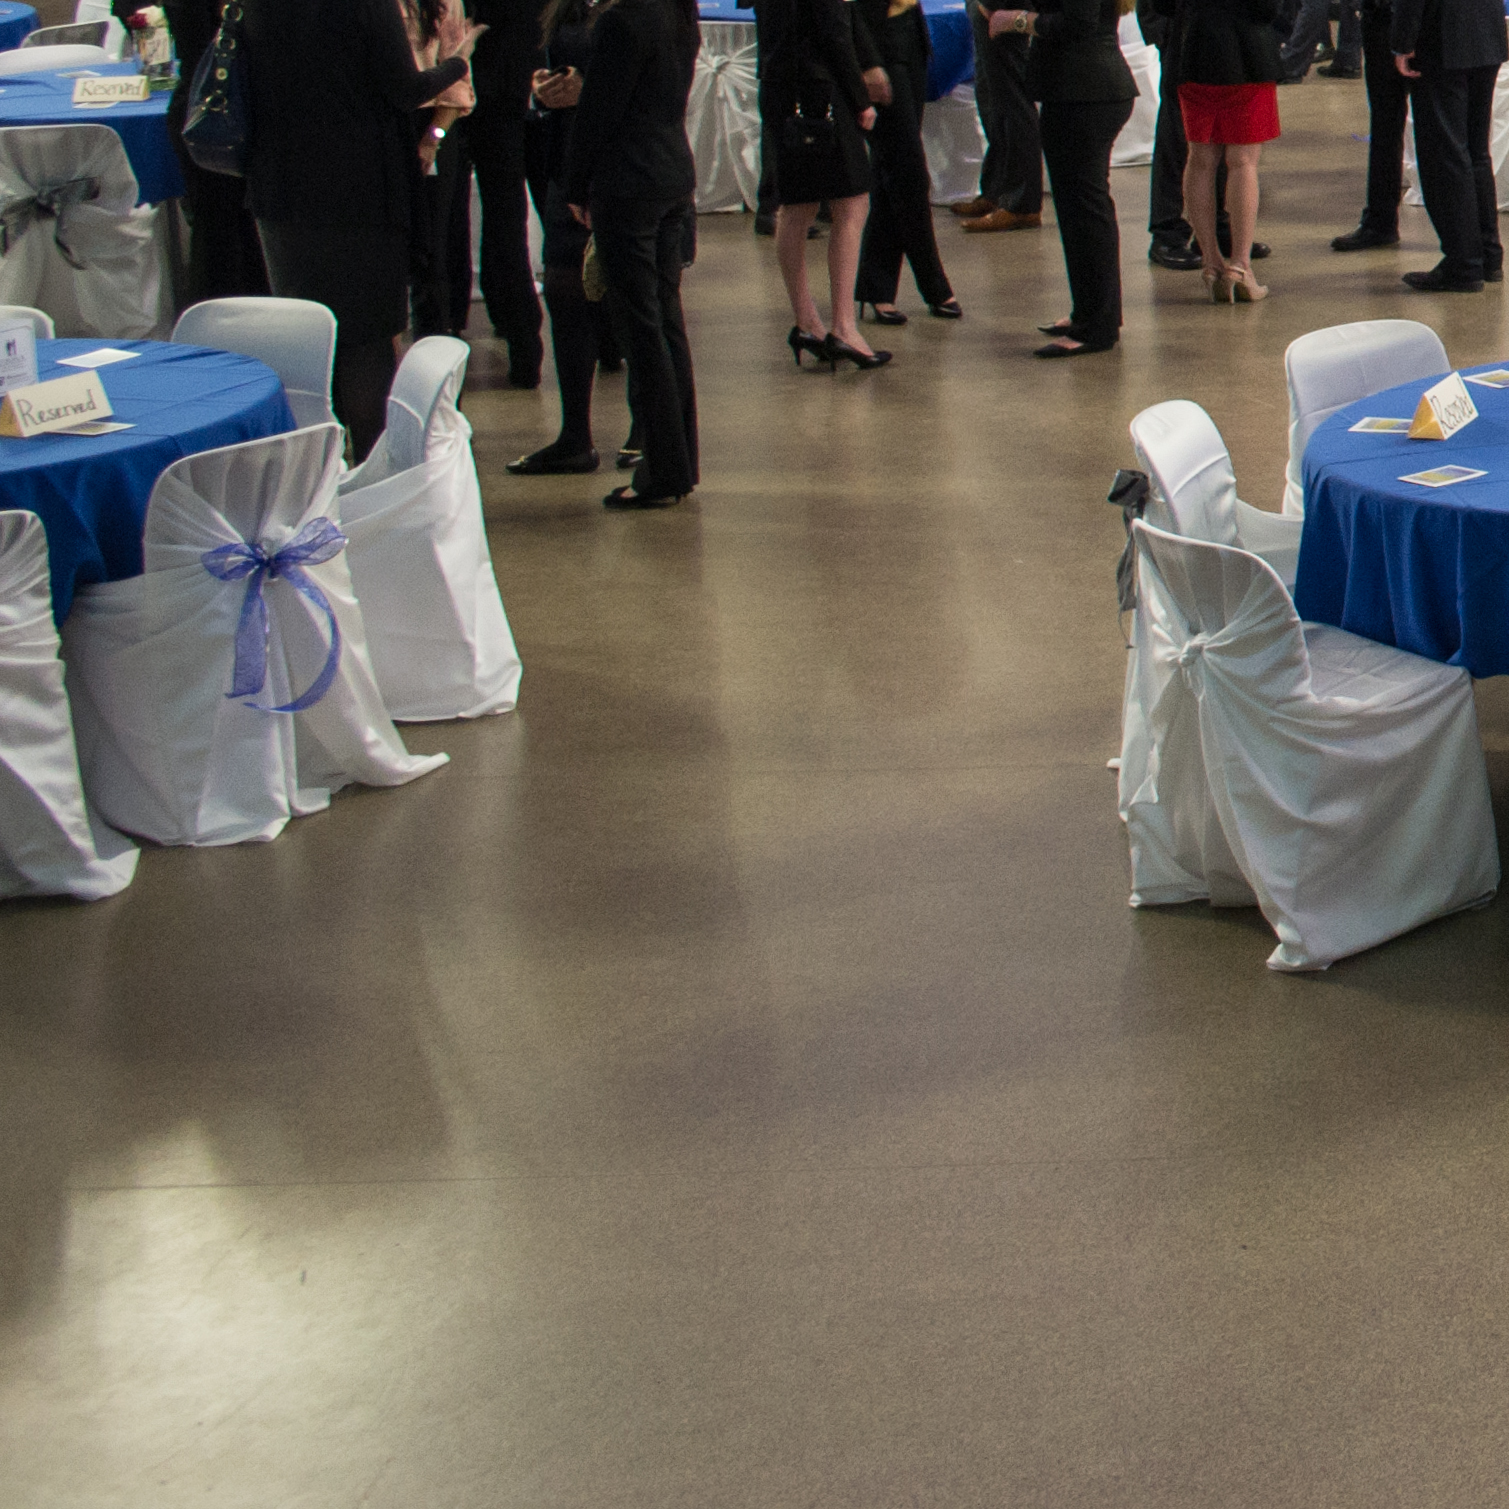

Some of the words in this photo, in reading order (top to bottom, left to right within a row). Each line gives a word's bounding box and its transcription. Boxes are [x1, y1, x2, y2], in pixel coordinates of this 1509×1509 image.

[80, 78, 144, 97] Reserved
[16, 388, 98, 428] Reserved
[1430, 376, 1475, 436] Reserved
